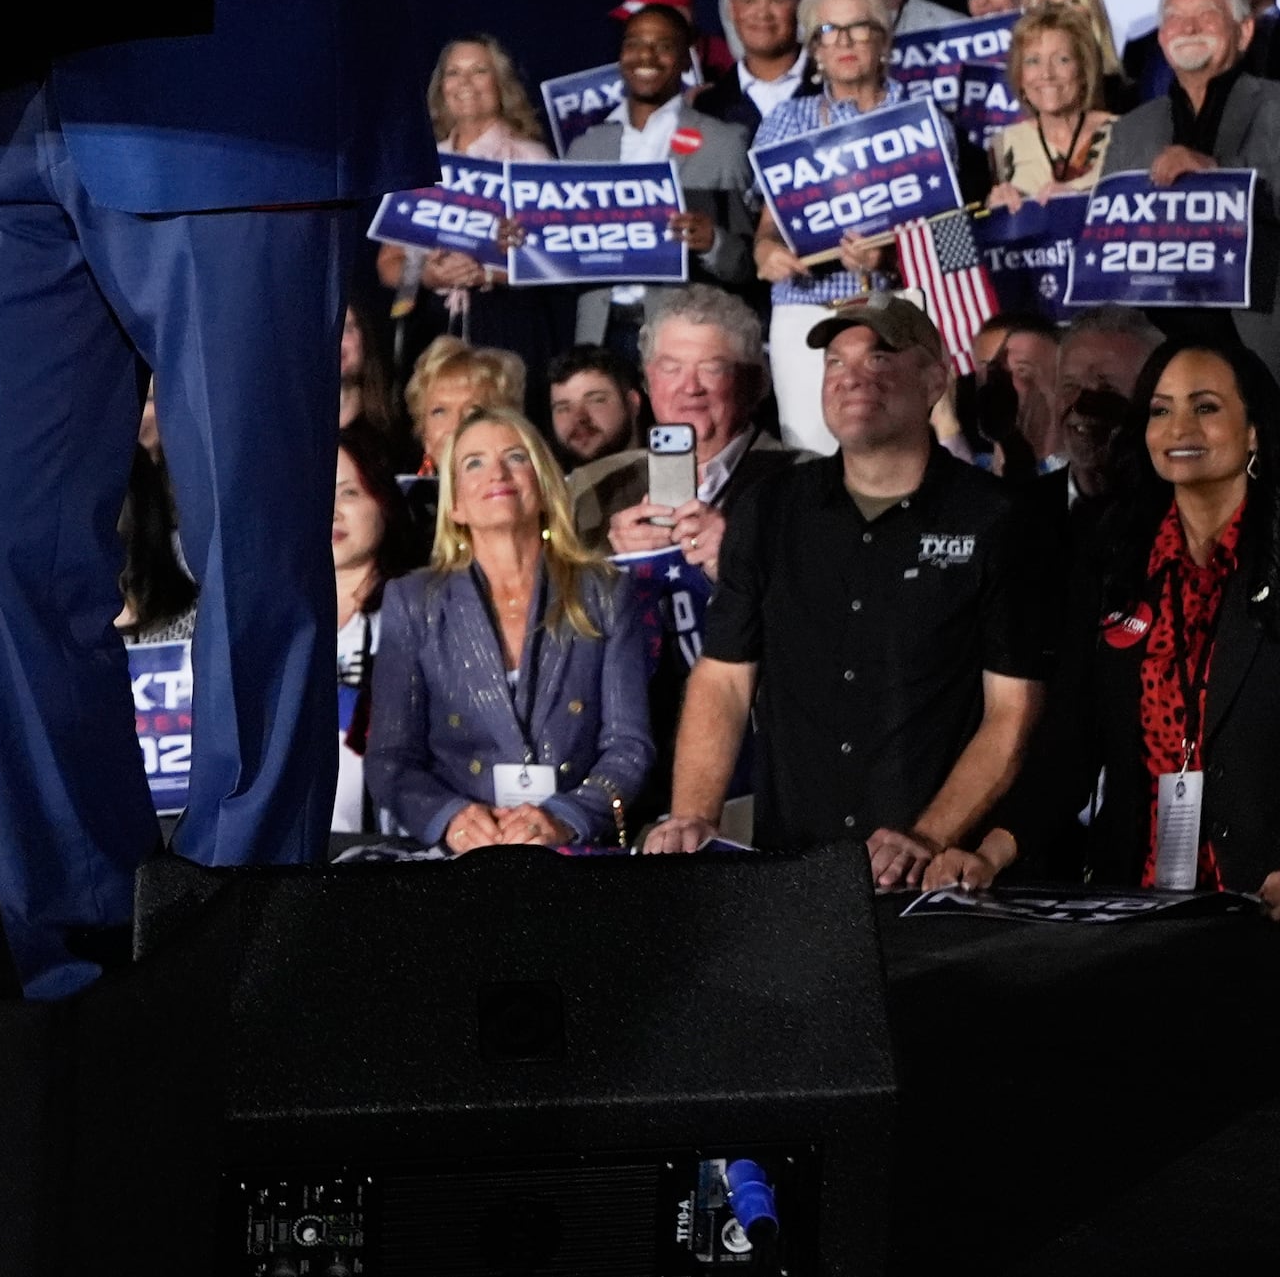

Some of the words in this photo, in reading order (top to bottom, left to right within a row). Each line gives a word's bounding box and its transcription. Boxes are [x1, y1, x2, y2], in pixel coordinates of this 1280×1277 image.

[763, 119, 937, 196] PAXTON
[512, 178, 677, 210] PAXTON
[803, 174, 923, 234] 2026
[1085, 191, 1246, 226] PAXTON
[411, 199, 500, 241] 202
[542, 222, 658, 253] 2026
[1101, 241, 1216, 272] 2026
